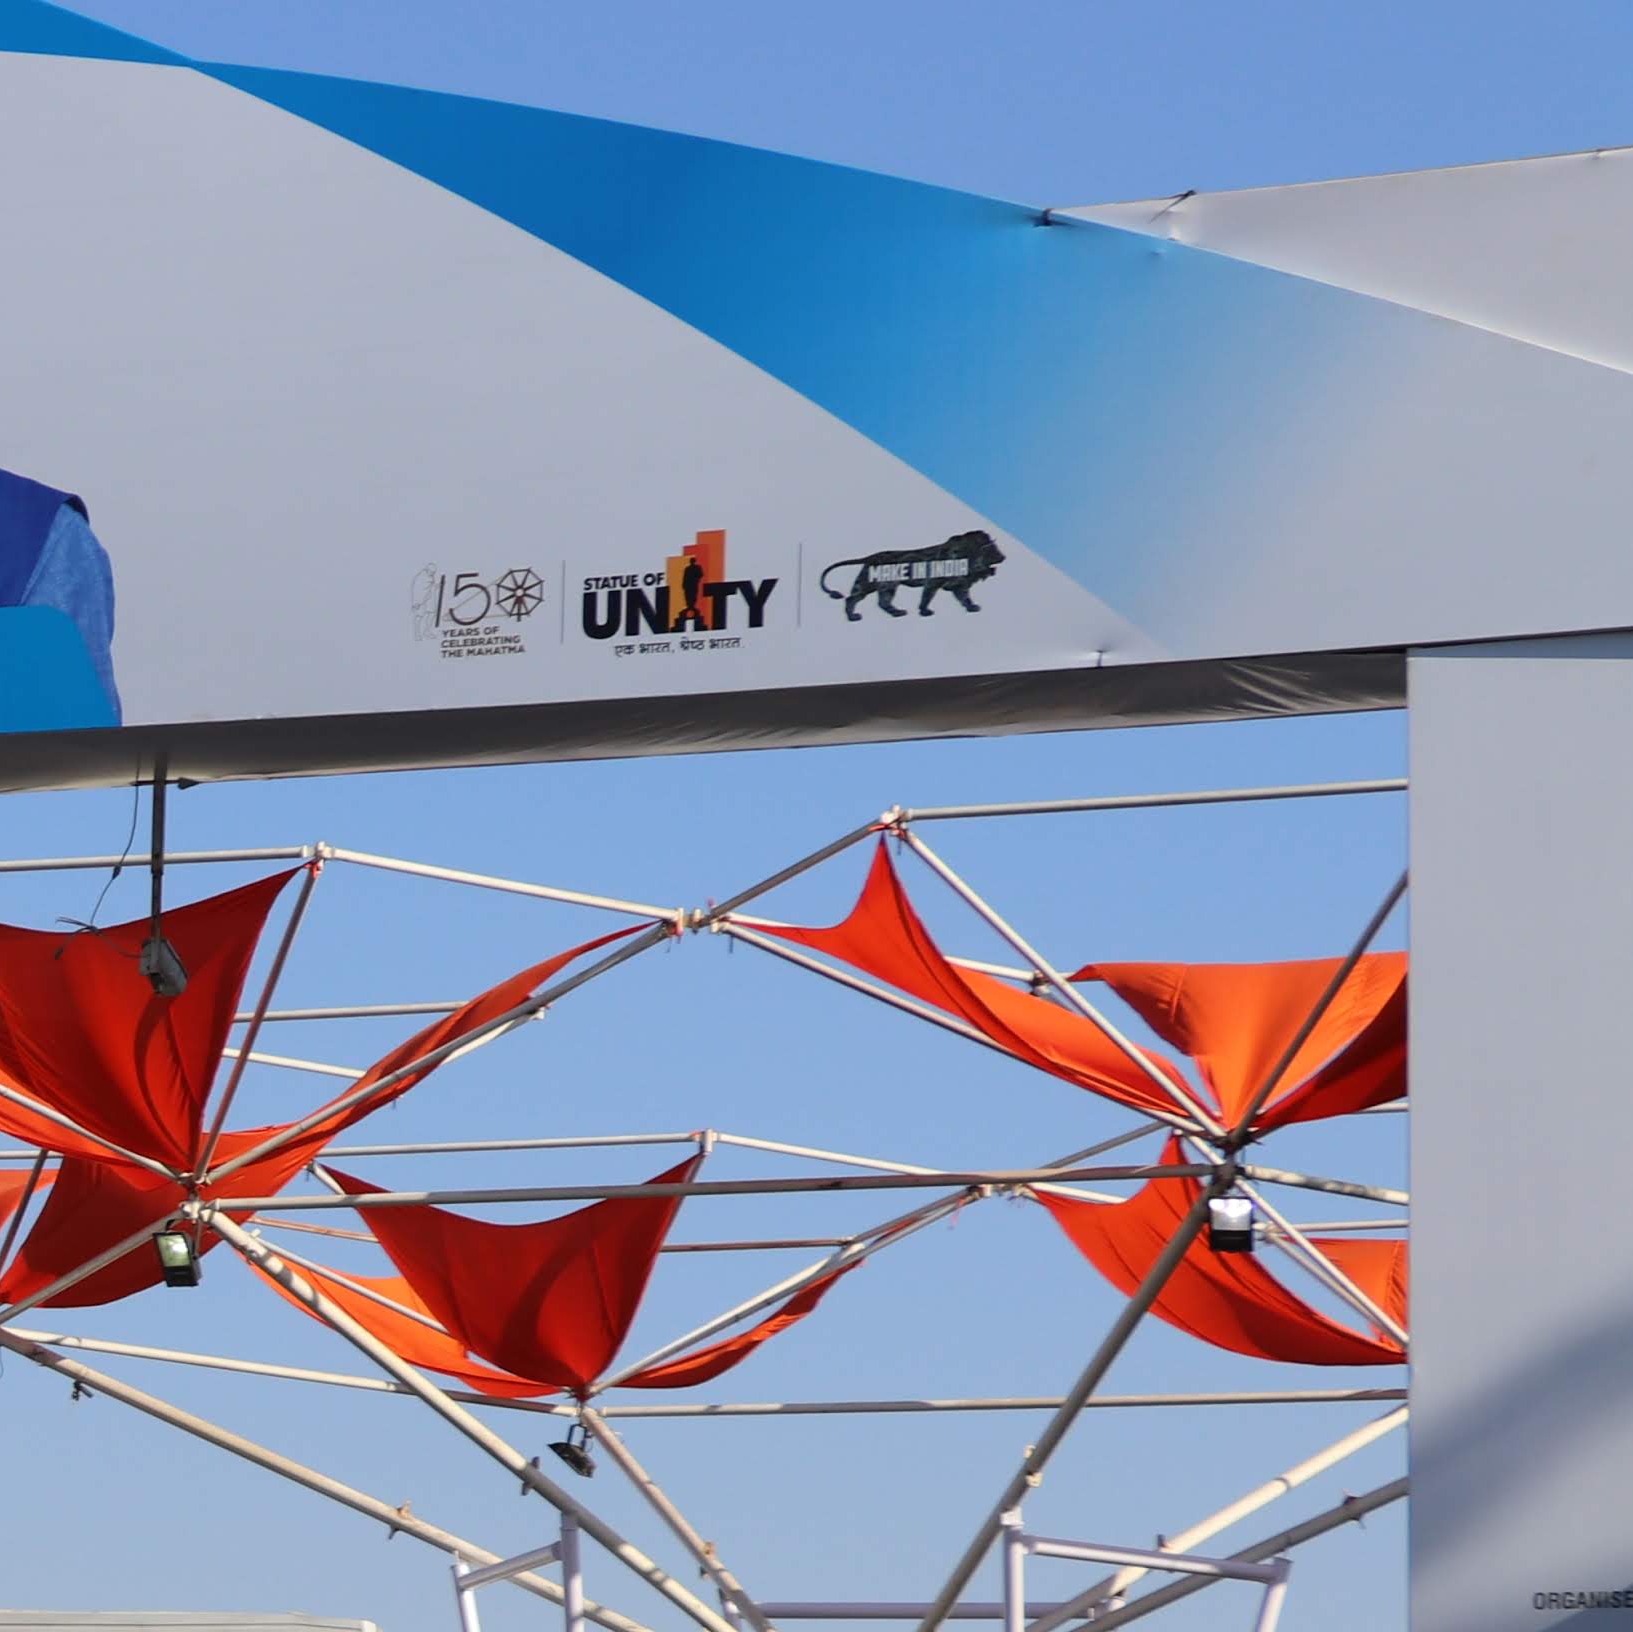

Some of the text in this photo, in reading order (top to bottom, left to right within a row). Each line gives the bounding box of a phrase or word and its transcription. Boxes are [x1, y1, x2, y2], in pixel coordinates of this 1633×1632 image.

[868, 559, 969, 582] MAKE IN INDIA
[583, 572, 666, 591] STATUE OF
[583, 562, 779, 640] UNITY
[441, 635, 521, 648] CELEBRATING
[442, 626, 500, 638] YEARS OF
[441, 645, 526, 658] THE MAHATMA
[1533, 1591, 1633, 1610] ORGANISE
